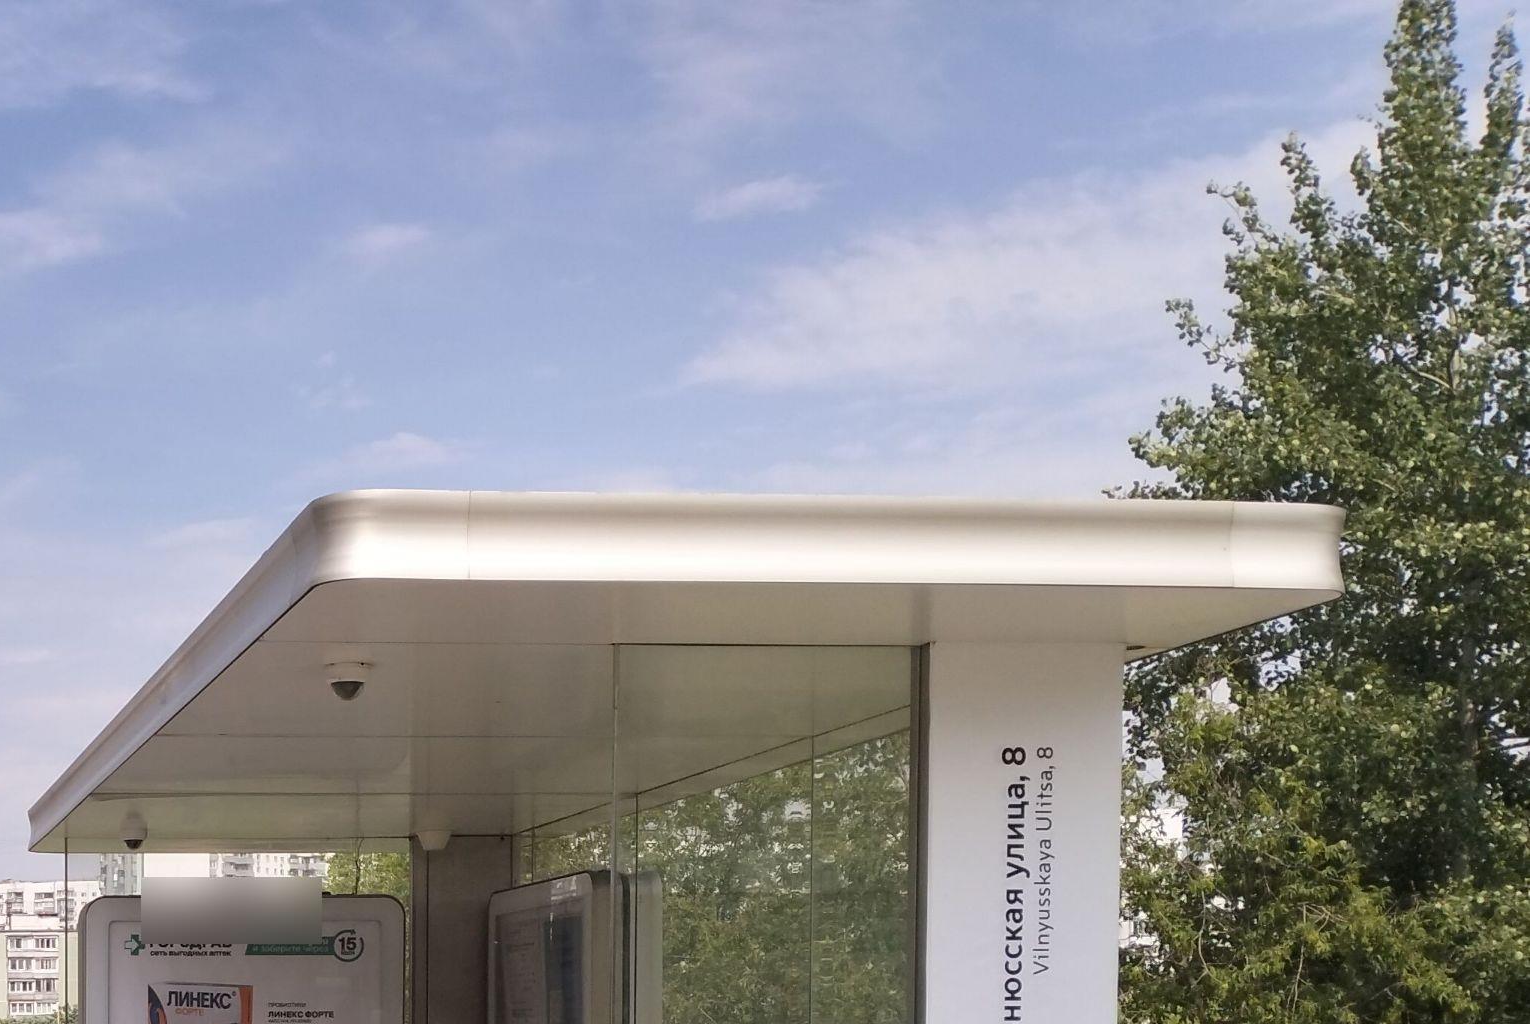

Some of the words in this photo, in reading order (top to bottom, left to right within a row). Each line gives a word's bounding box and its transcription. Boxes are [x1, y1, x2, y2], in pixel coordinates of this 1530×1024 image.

[1001, 746, 1026, 766] 8
[1036, 746, 1054, 759] 8
[1035, 765, 1056, 831] Ulitsa,
[1006, 775, 1030, 879] улица,
[1032, 839, 1055, 975] Vilnyusskaya
[338, 936, 357, 951] 15
[167, 990, 232, 1009] ЛИНЕКС
